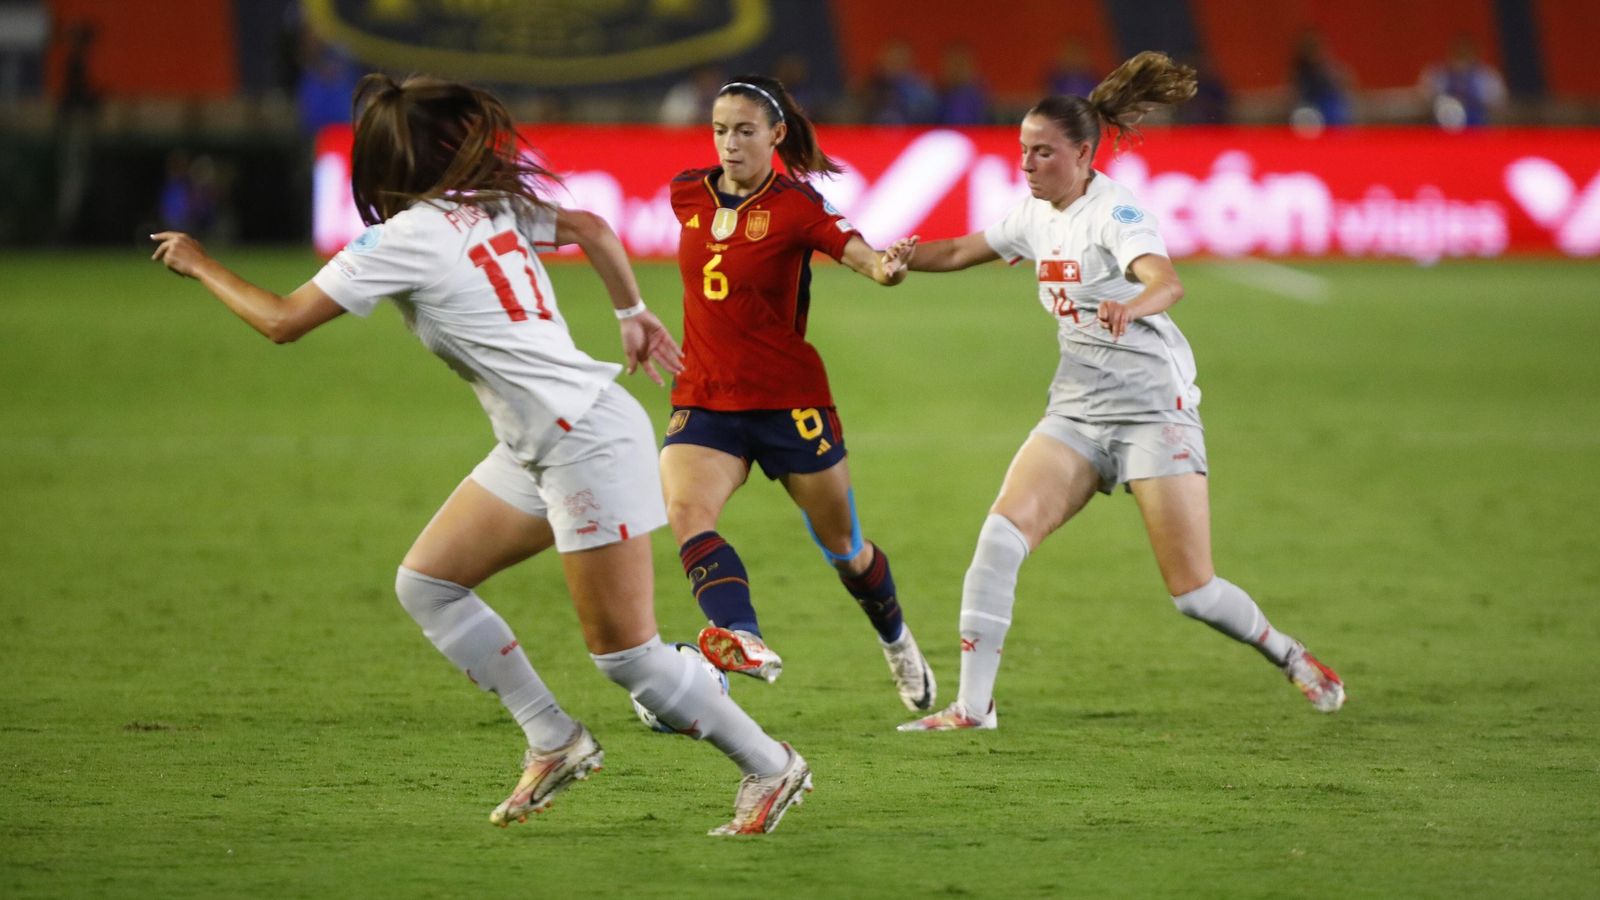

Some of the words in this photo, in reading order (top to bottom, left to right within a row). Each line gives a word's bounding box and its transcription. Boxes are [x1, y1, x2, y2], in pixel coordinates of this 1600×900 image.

[969, 150, 1335, 256] hcón
[468, 229, 553, 322] 17
[703, 254, 729, 300] 6
[1048, 287, 1080, 324] 14
[791, 407, 824, 440] 6
